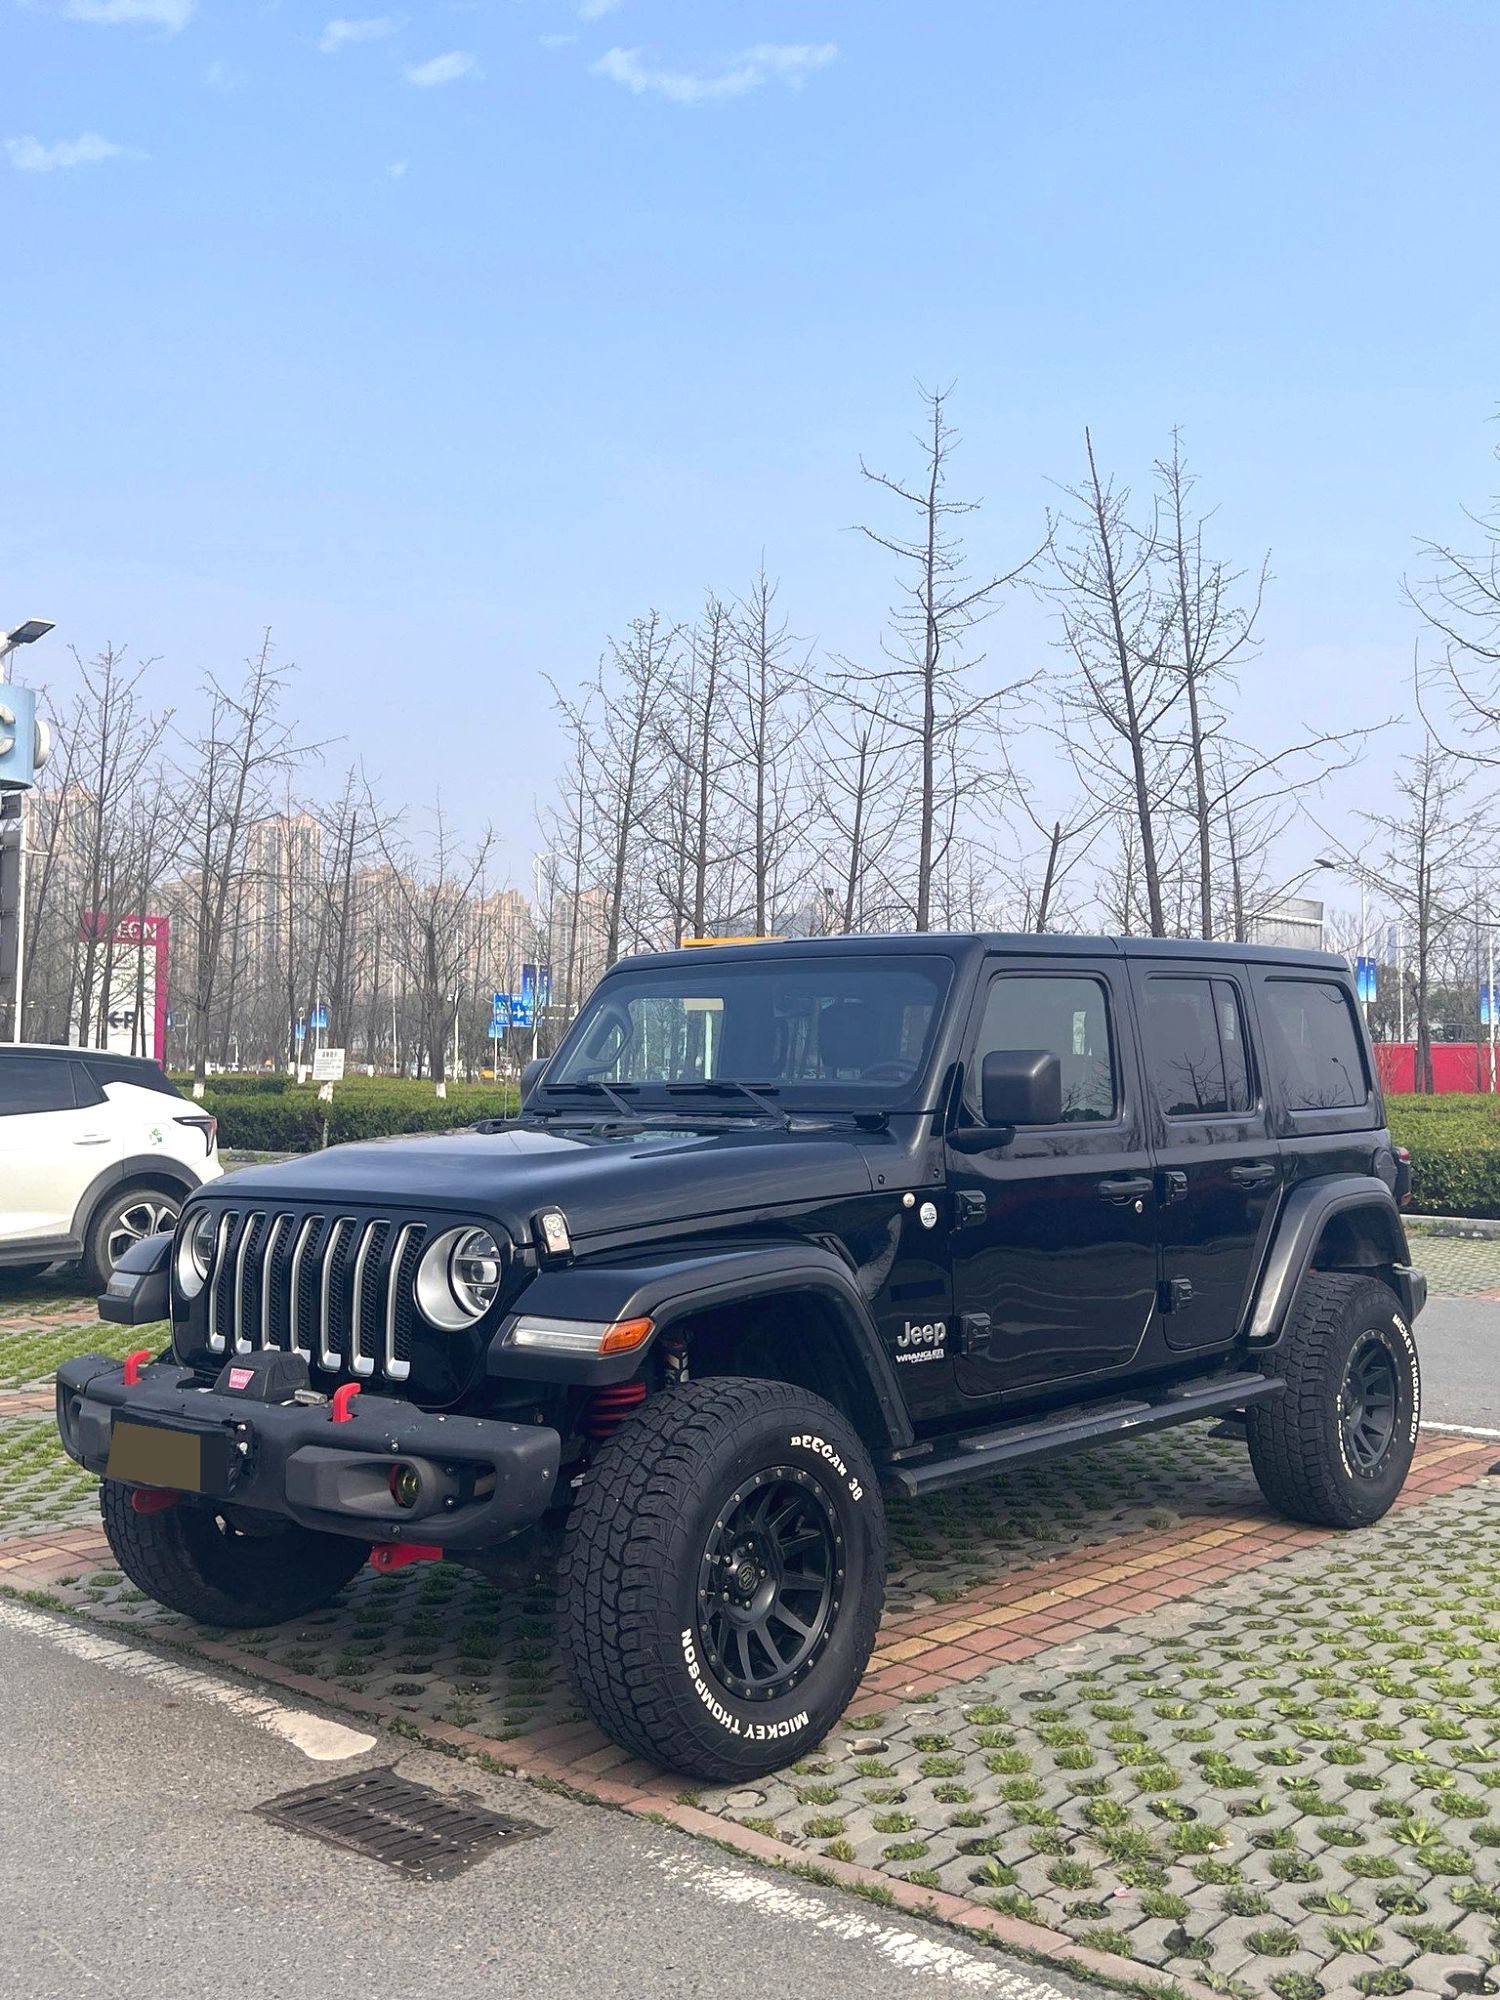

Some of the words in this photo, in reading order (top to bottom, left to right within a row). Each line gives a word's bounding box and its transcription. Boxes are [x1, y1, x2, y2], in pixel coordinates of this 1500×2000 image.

[896, 1348, 945, 1363] WRANGLER
[897, 1321, 946, 1347] Jeep
[1391, 1313, 1415, 1355] MICKEY
[1408, 1356, 1420, 1444] THOMPSON
[790, 1435, 848, 1477] DEEGAN
[848, 1477, 863, 1502] 38
[681, 1628, 741, 1735] THOMPSON
[743, 1711, 810, 1740] MICKEY
